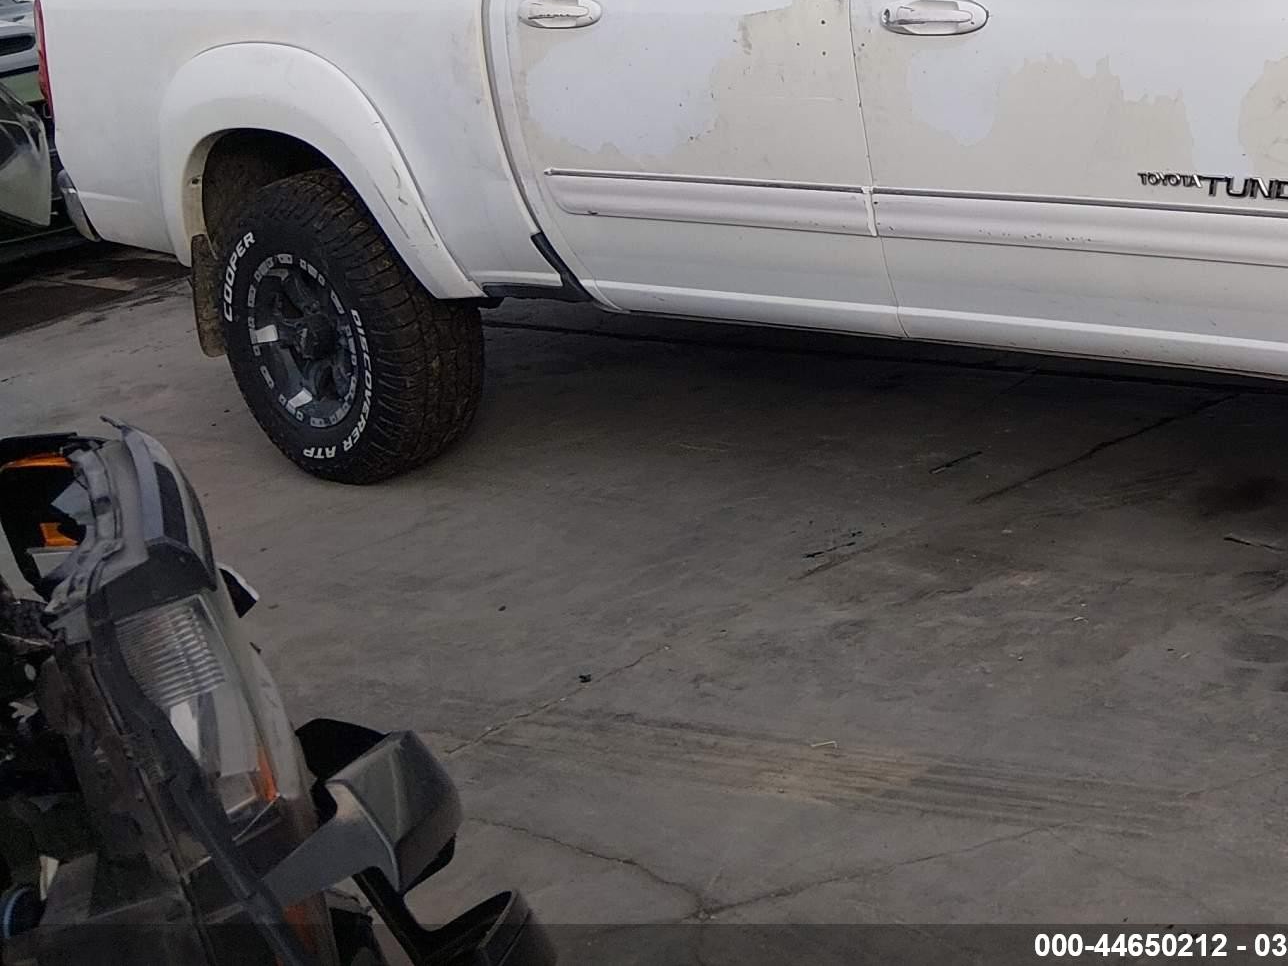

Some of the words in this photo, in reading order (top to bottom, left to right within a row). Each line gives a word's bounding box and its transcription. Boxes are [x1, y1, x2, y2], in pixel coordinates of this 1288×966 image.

[1138, 172, 1203, 188] TOYOTA
[222, 232, 256, 322] COOPER
[342, 309, 373, 452] DISCOVERER
[303, 445, 337, 459] ATP
